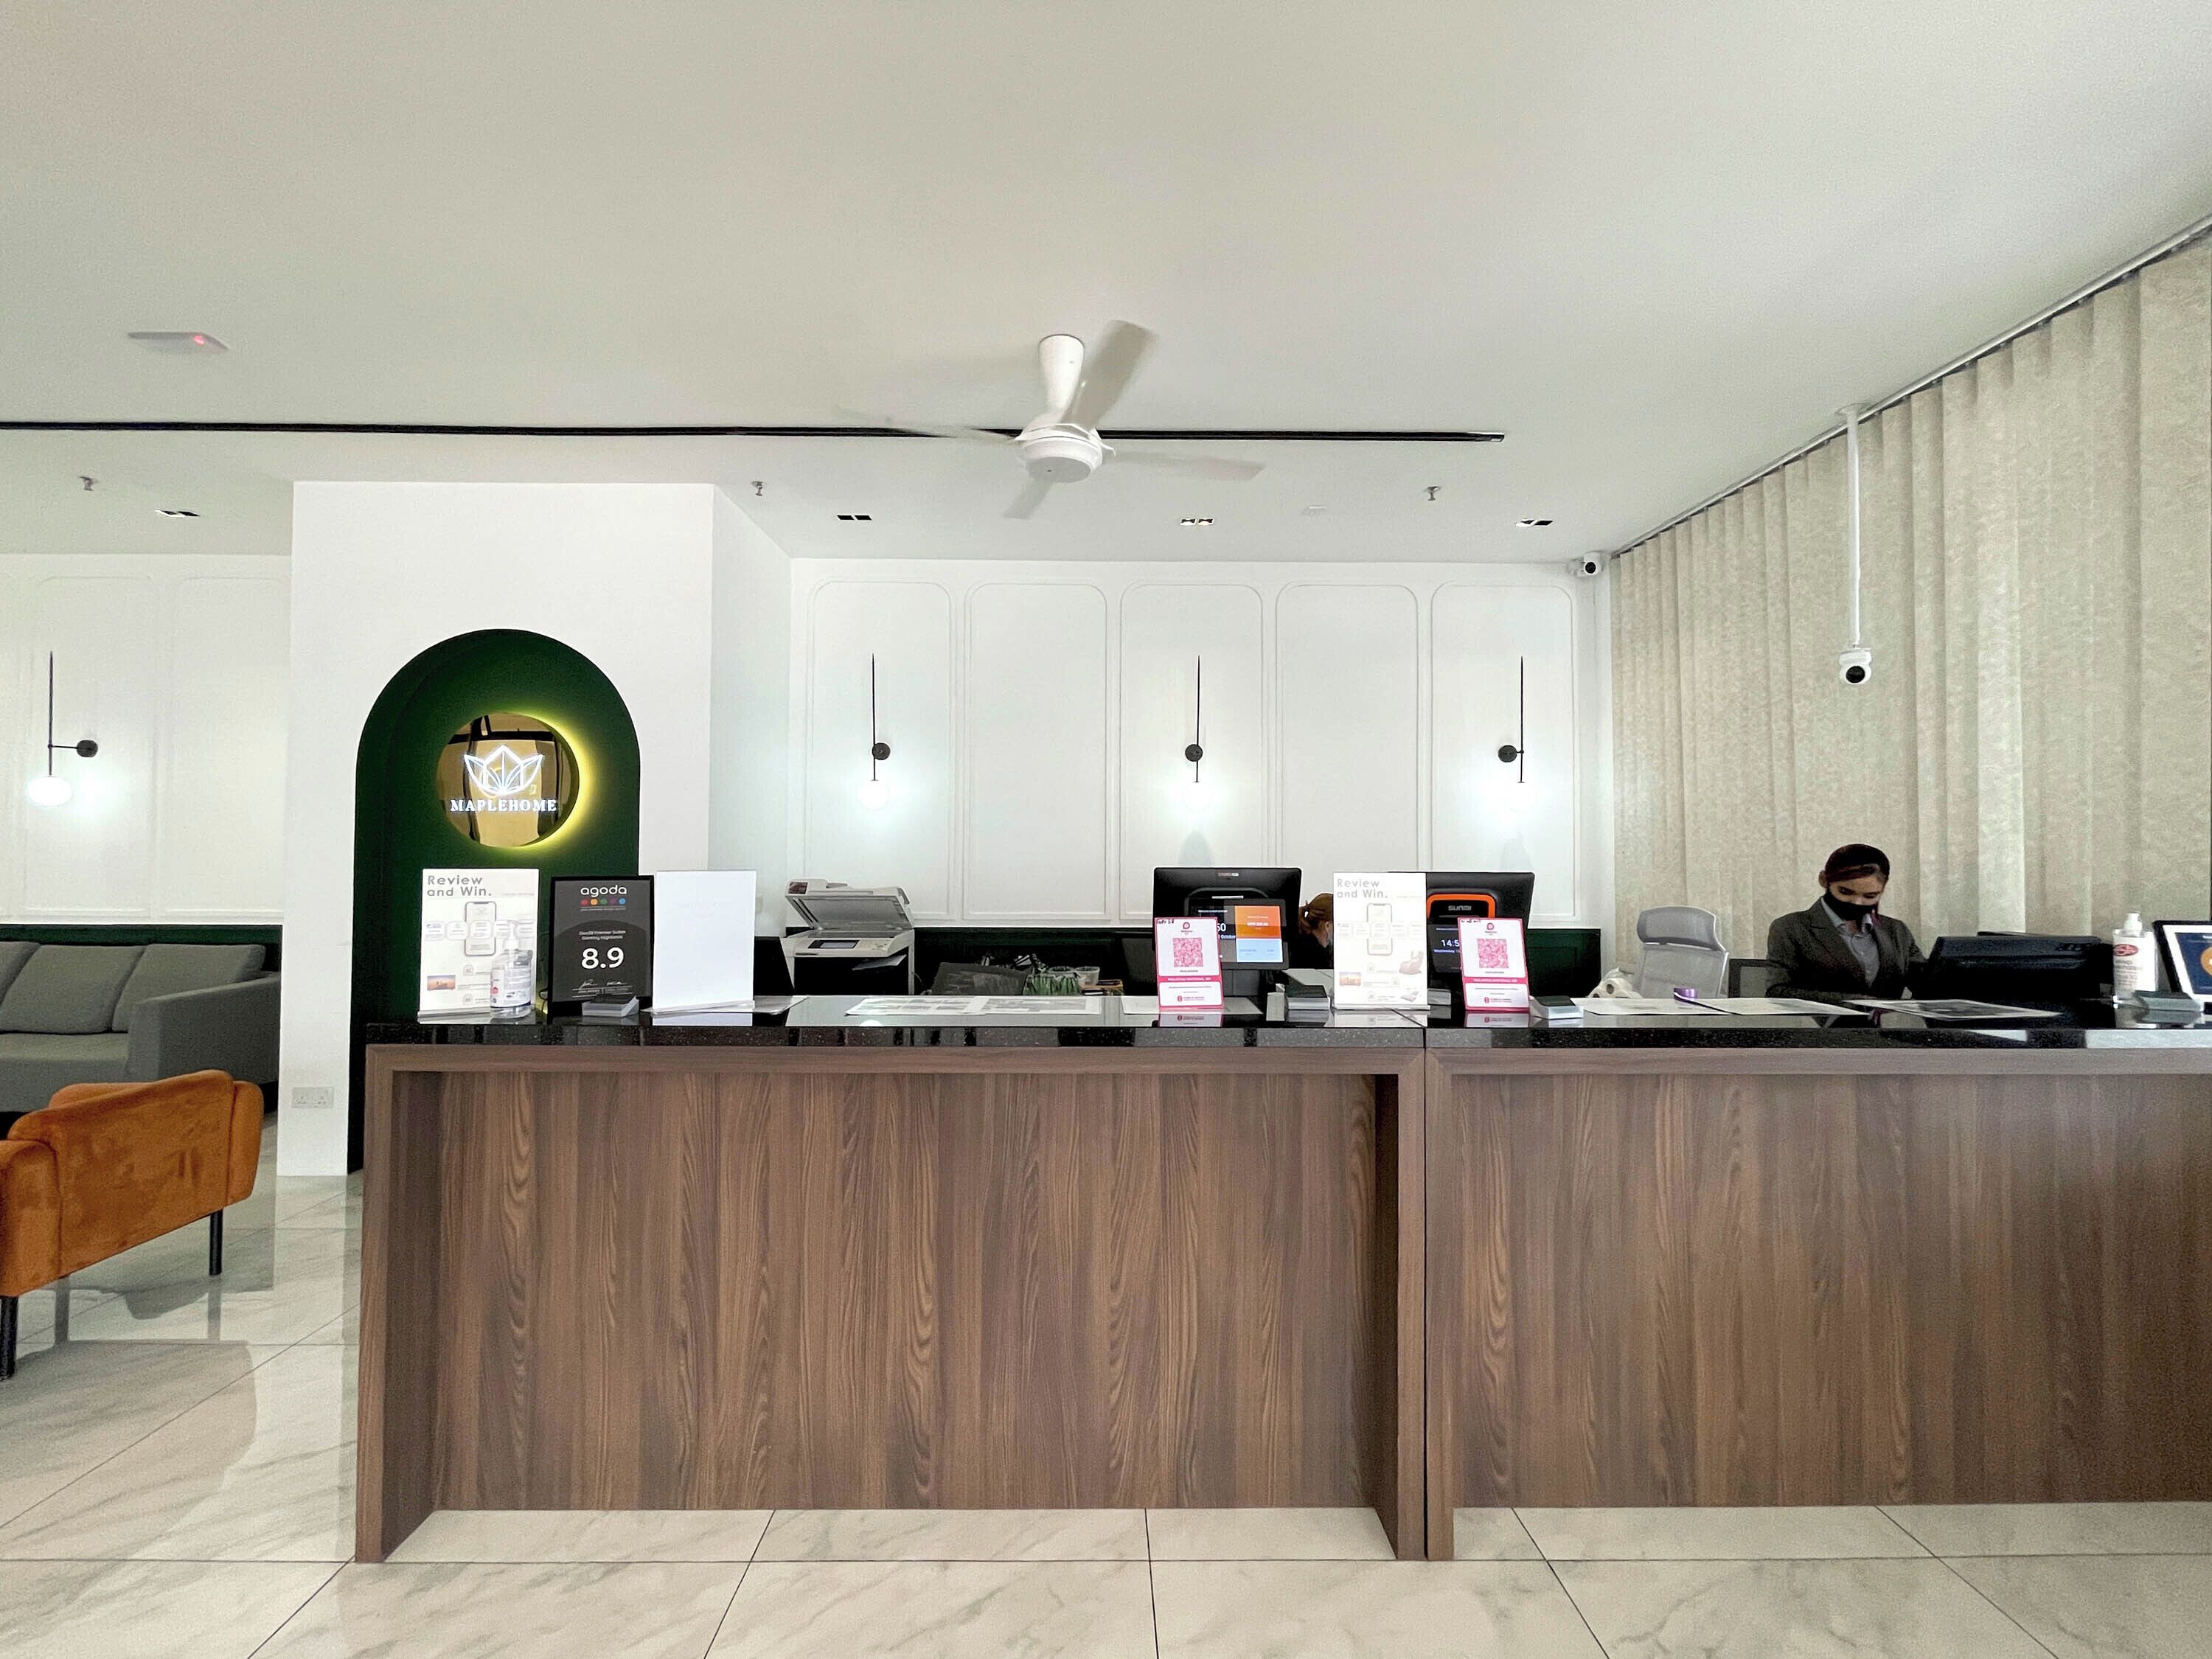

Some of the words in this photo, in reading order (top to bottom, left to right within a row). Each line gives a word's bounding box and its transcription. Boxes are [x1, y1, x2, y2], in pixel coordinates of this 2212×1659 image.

[450, 799, 557, 812] MAPLEHOME
[428, 874, 483, 886] Review
[1337, 878, 1380, 888] Review
[427, 887, 454, 897] and
[460, 886, 492, 897] Win.
[580, 884, 627, 898] agoda
[1336, 889, 1357, 898] and
[1363, 888, 1388, 898] Win.
[581, 947, 625, 970] 8.9
